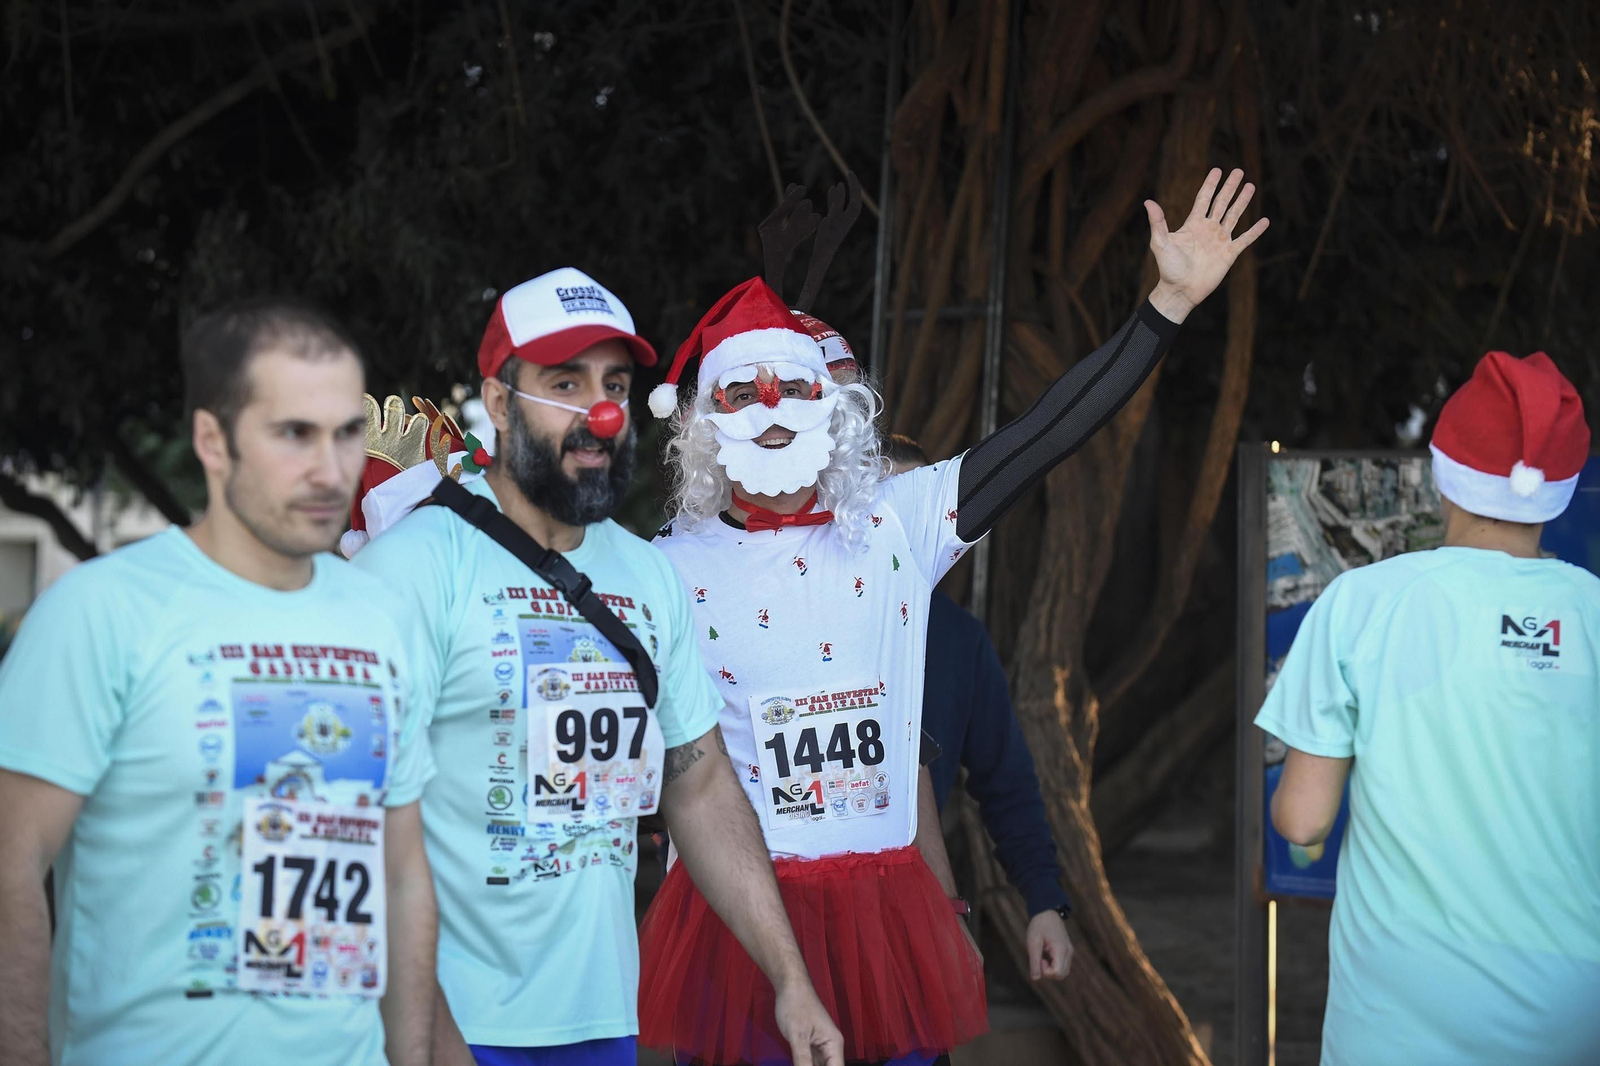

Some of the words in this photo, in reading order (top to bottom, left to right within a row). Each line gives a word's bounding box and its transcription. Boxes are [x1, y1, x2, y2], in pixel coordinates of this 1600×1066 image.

[795, 698, 808, 707] III
[810, 695, 829, 705] SAN
[831, 687, 880, 702] SILVESTRE
[808, 696, 873, 713] GADITANA
[556, 706, 648, 763] 997
[764, 719, 885, 778] 1448
[776, 803, 810, 815] MERCHAN
[253, 855, 373, 923] 1742
